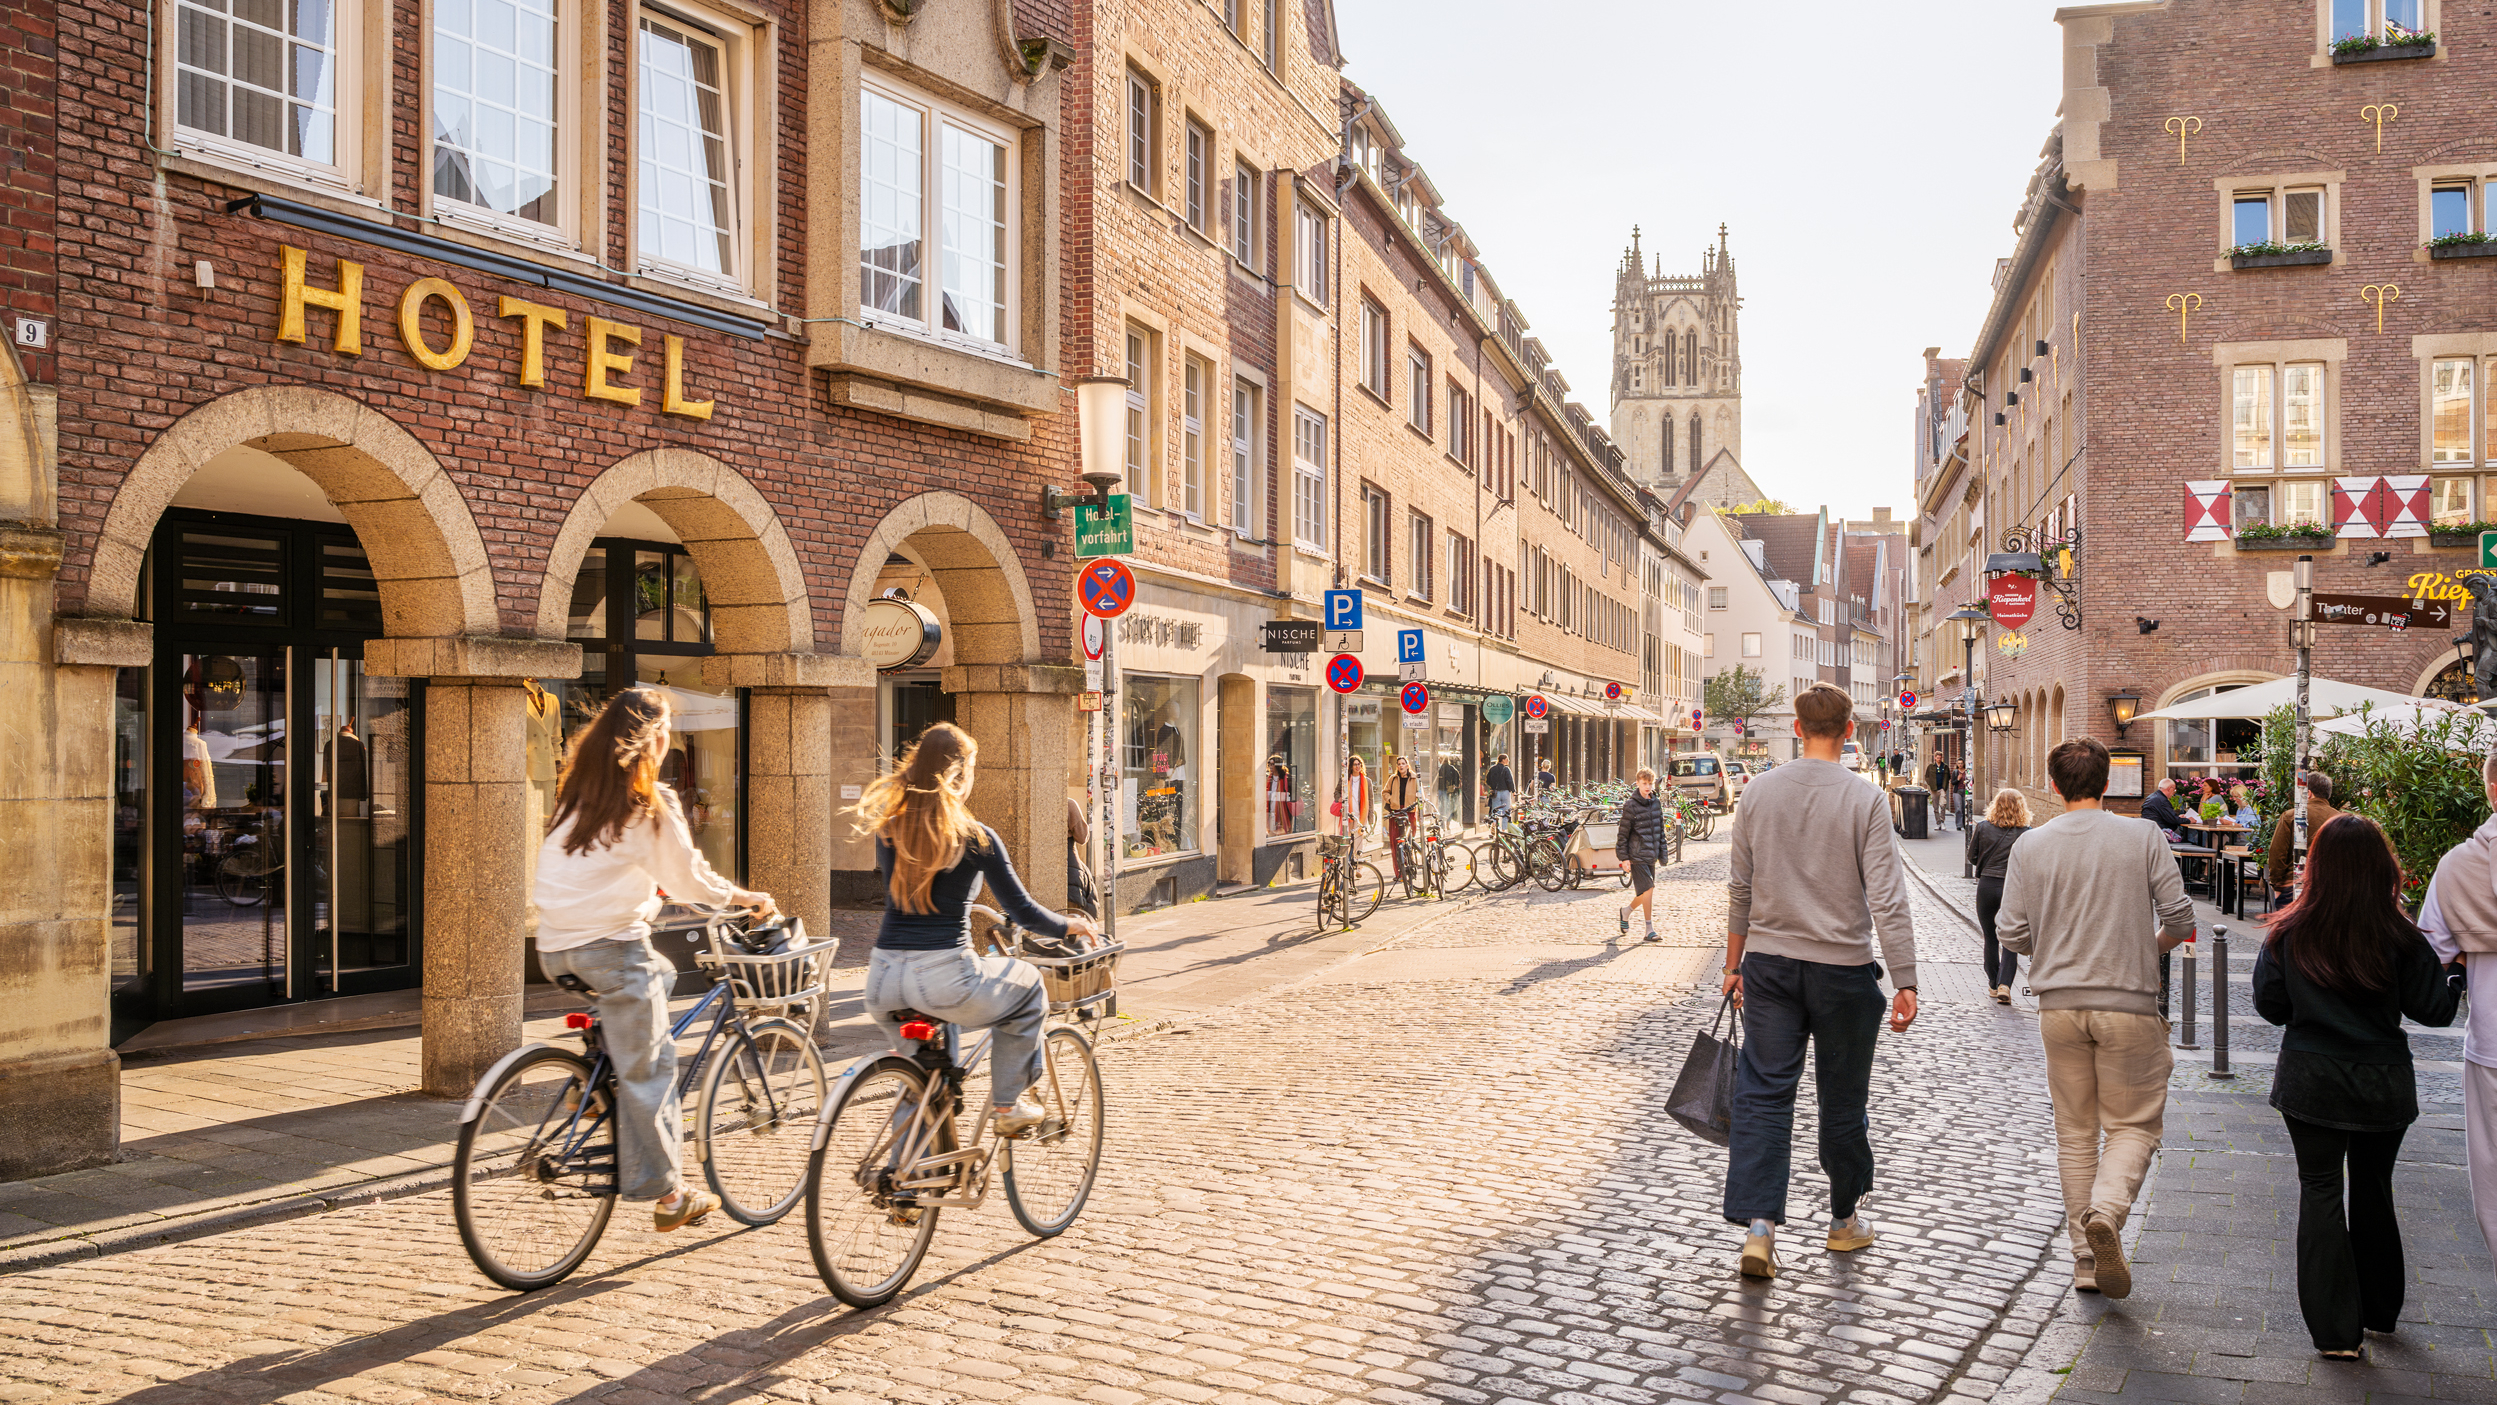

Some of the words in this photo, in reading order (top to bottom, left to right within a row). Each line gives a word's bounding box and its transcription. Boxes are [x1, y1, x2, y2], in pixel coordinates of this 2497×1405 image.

[26, 323, 37, 342] 9
[277, 244, 715, 420] HOTEL
[1085, 506, 1121, 522] Hoel-
[1081, 530, 1128, 545] vorfahrt
[1992, 594, 2033, 606] Kiepenkerl
[1333, 594, 1354, 626] P
[2316, 602, 2365, 616] Thater
[1267, 629, 1316, 640] NISCHE
[1403, 633, 1419, 659] P
[1280, 652, 1310, 671] NISCHE
